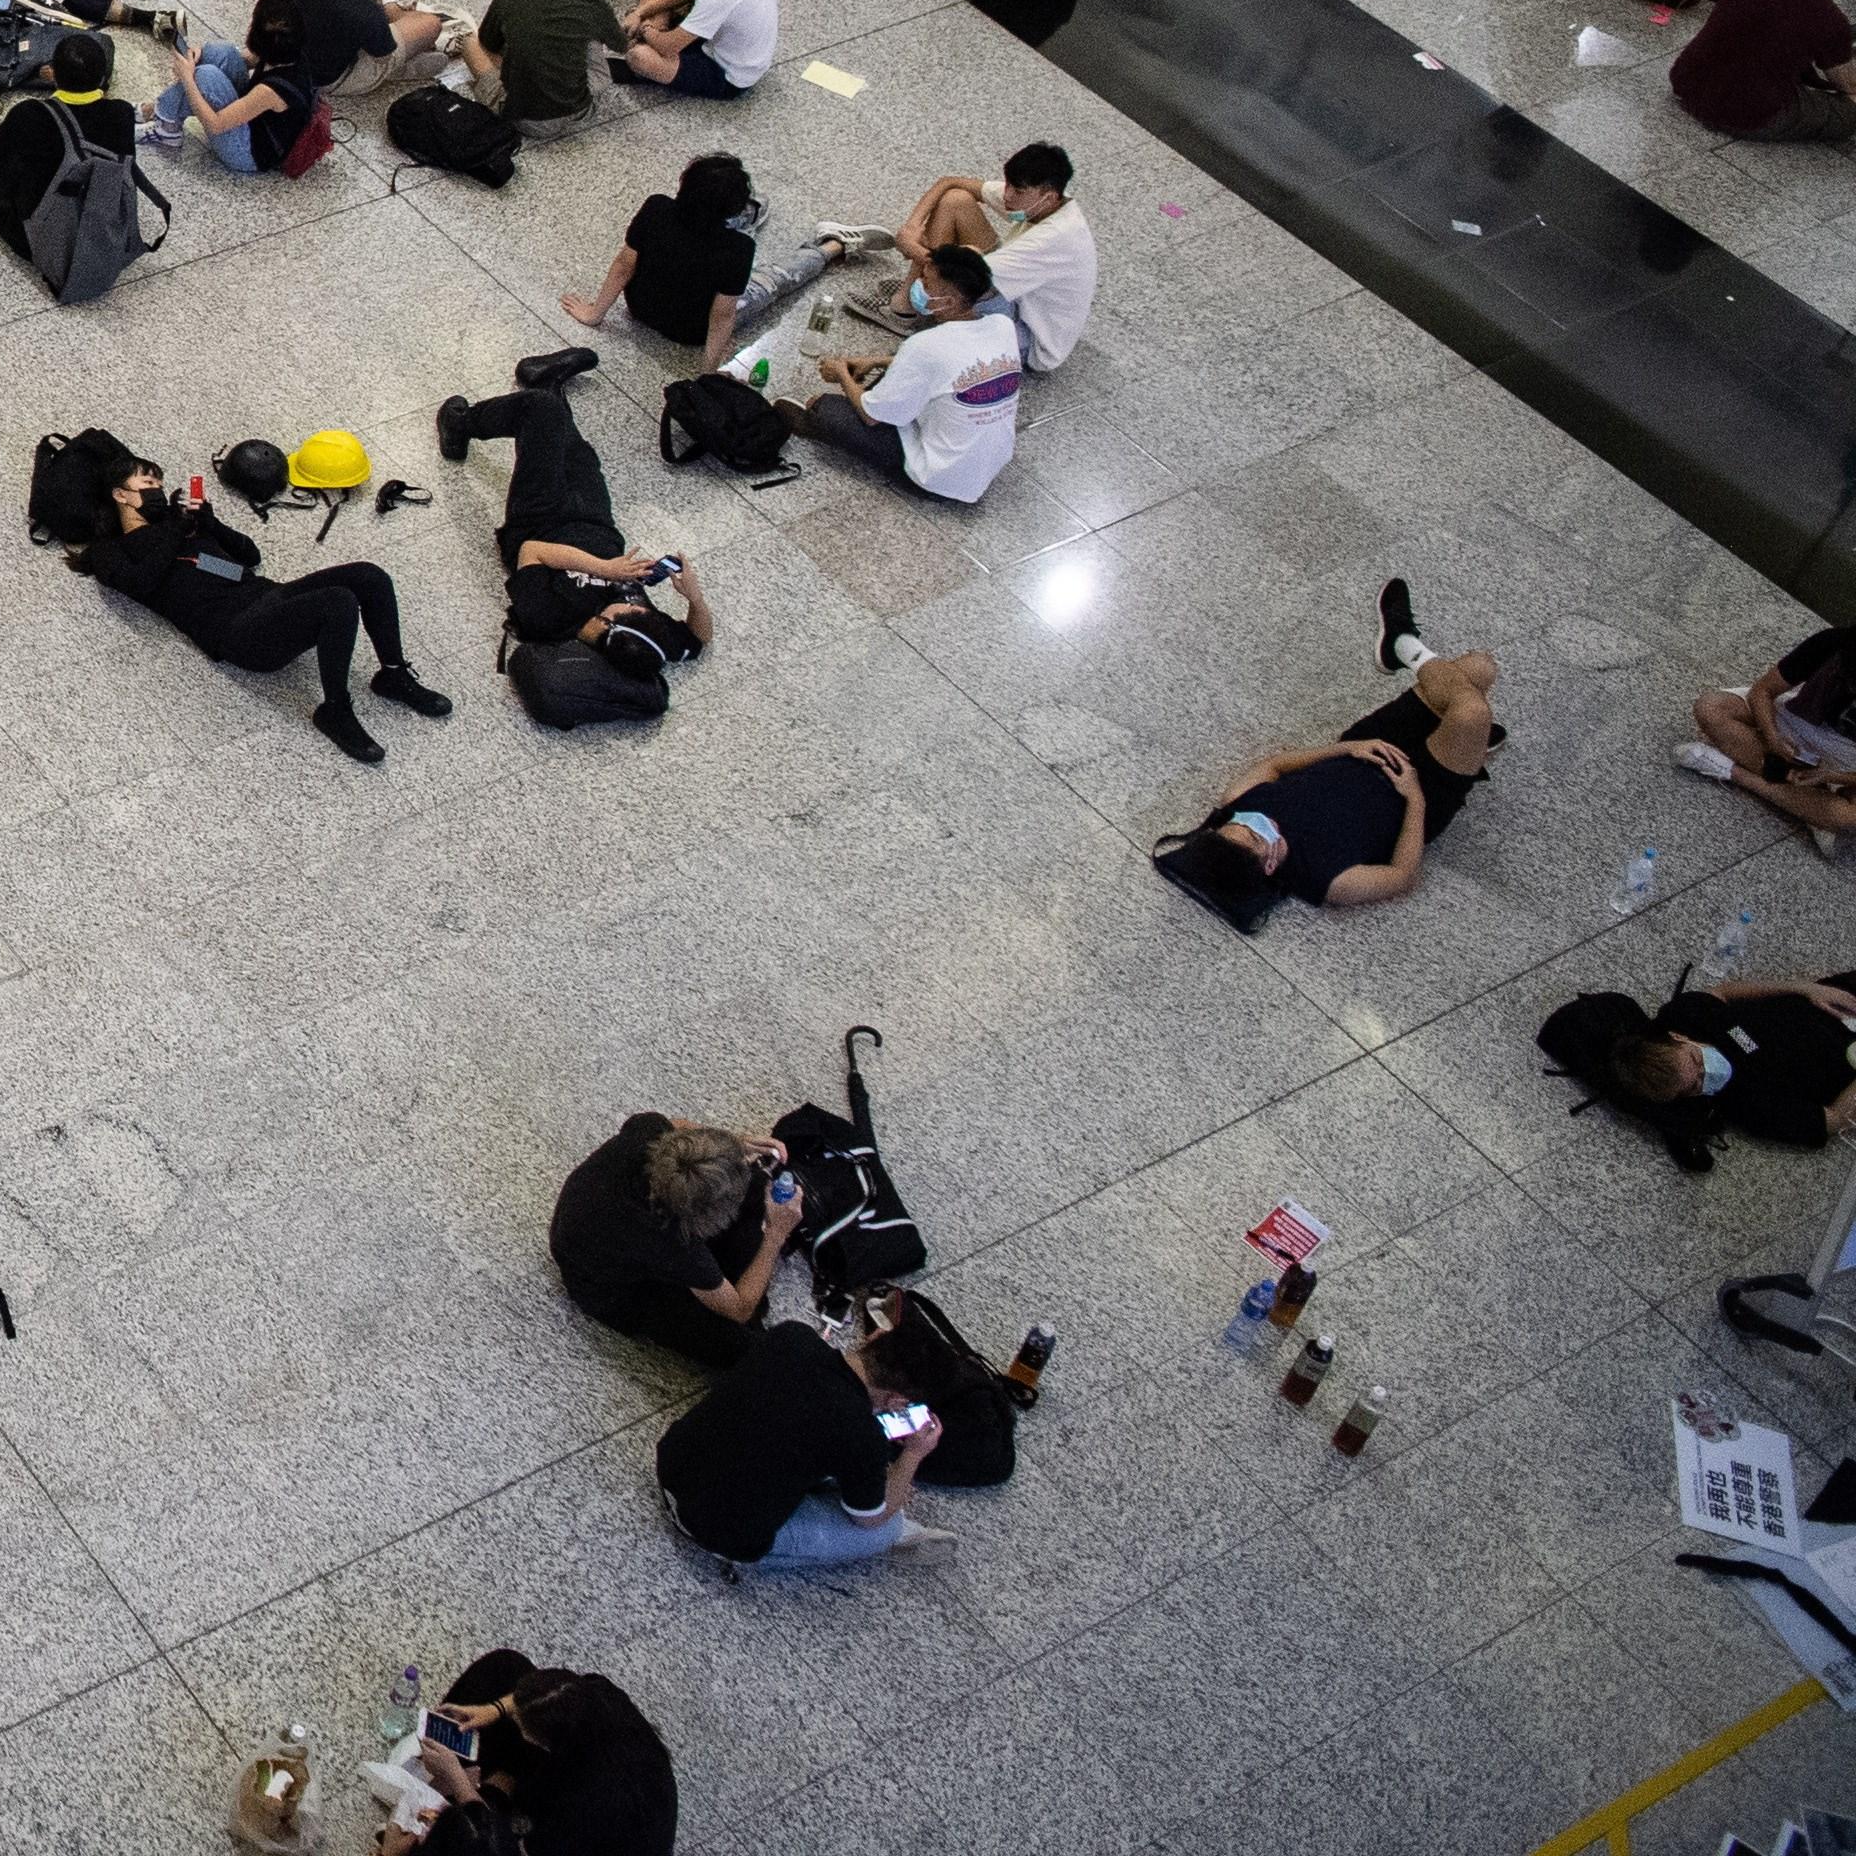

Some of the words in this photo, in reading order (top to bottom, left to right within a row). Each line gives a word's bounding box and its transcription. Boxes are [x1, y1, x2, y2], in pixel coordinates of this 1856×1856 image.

[1705, 1469, 1731, 1523] 我再也
[1730, 1459, 1758, 1530] 不能尊重
[1757, 1467, 1786, 1539] 香港警察
